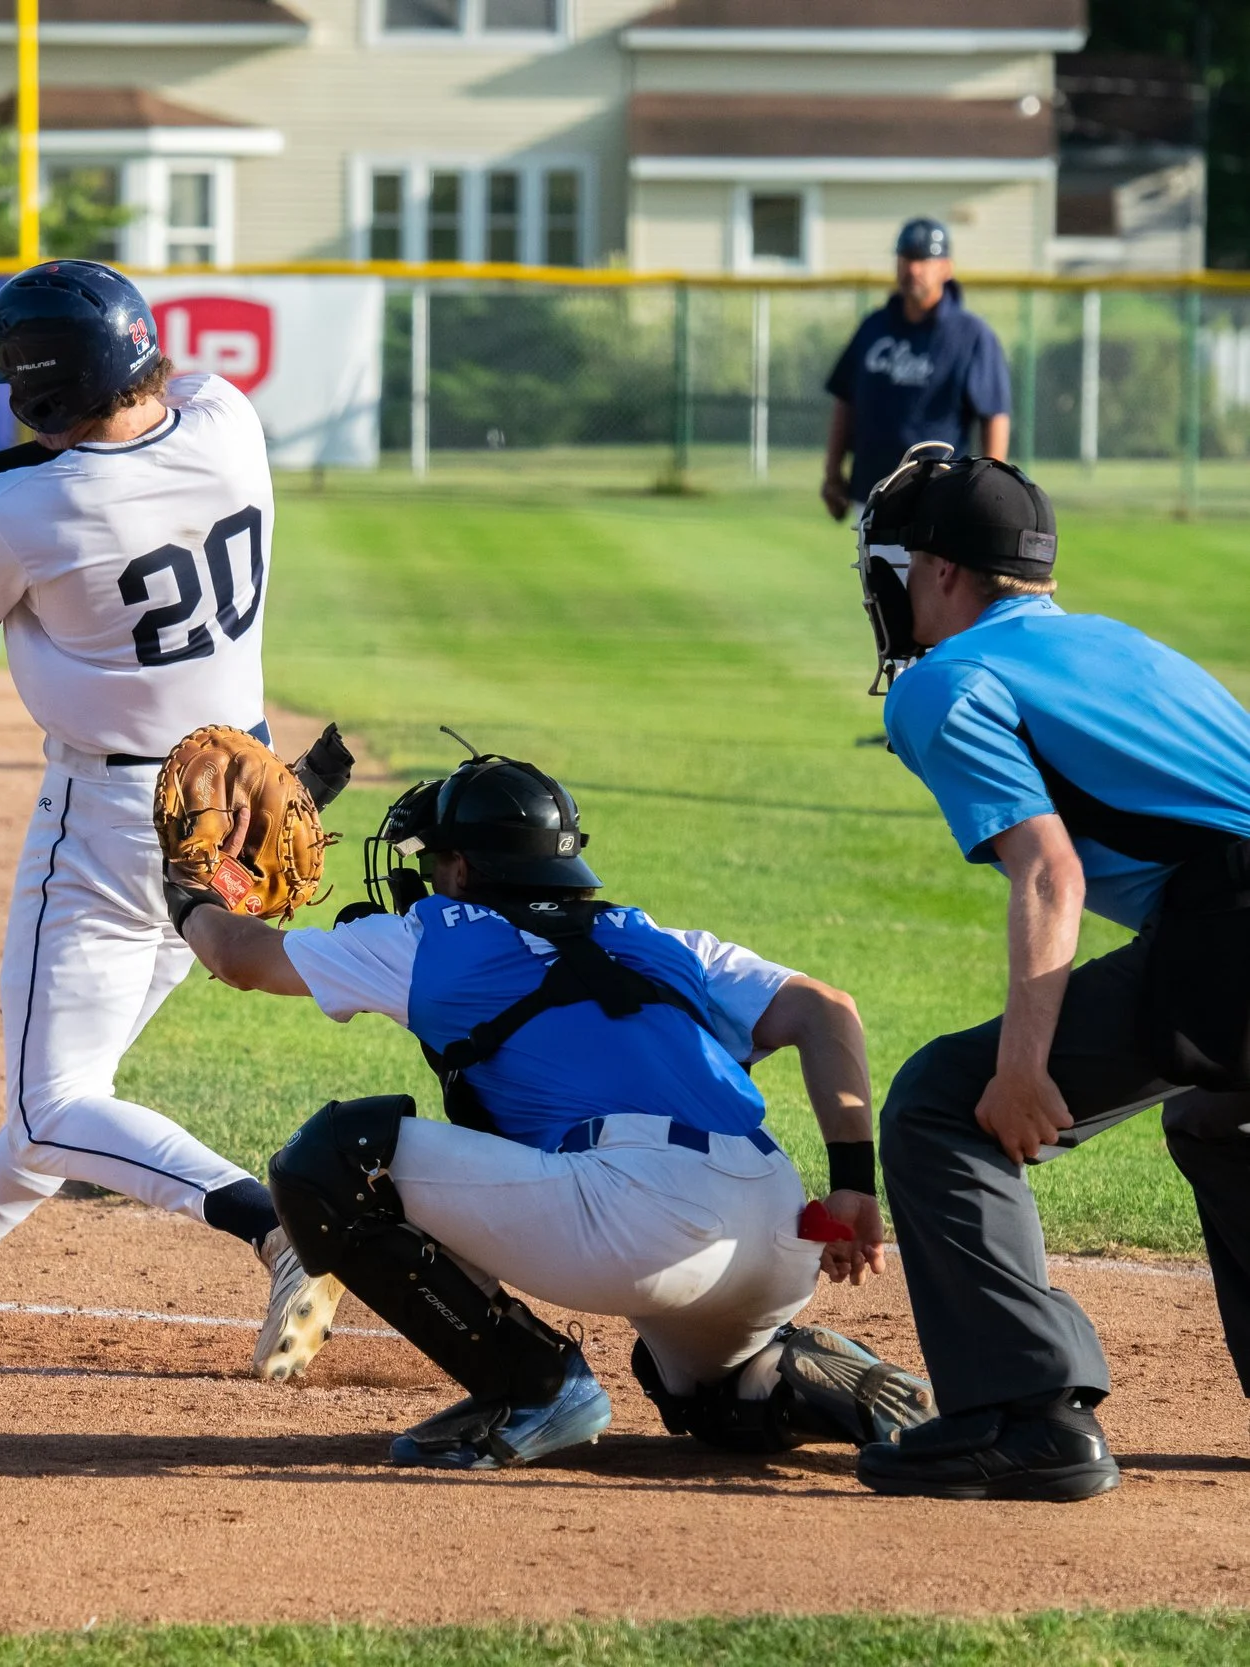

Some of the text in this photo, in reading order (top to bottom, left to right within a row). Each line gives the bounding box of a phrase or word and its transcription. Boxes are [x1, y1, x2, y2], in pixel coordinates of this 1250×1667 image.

[129, 317, 147, 344] 20
[16, 359, 57, 372] RAWLINGS
[118, 505, 264, 667] 20
